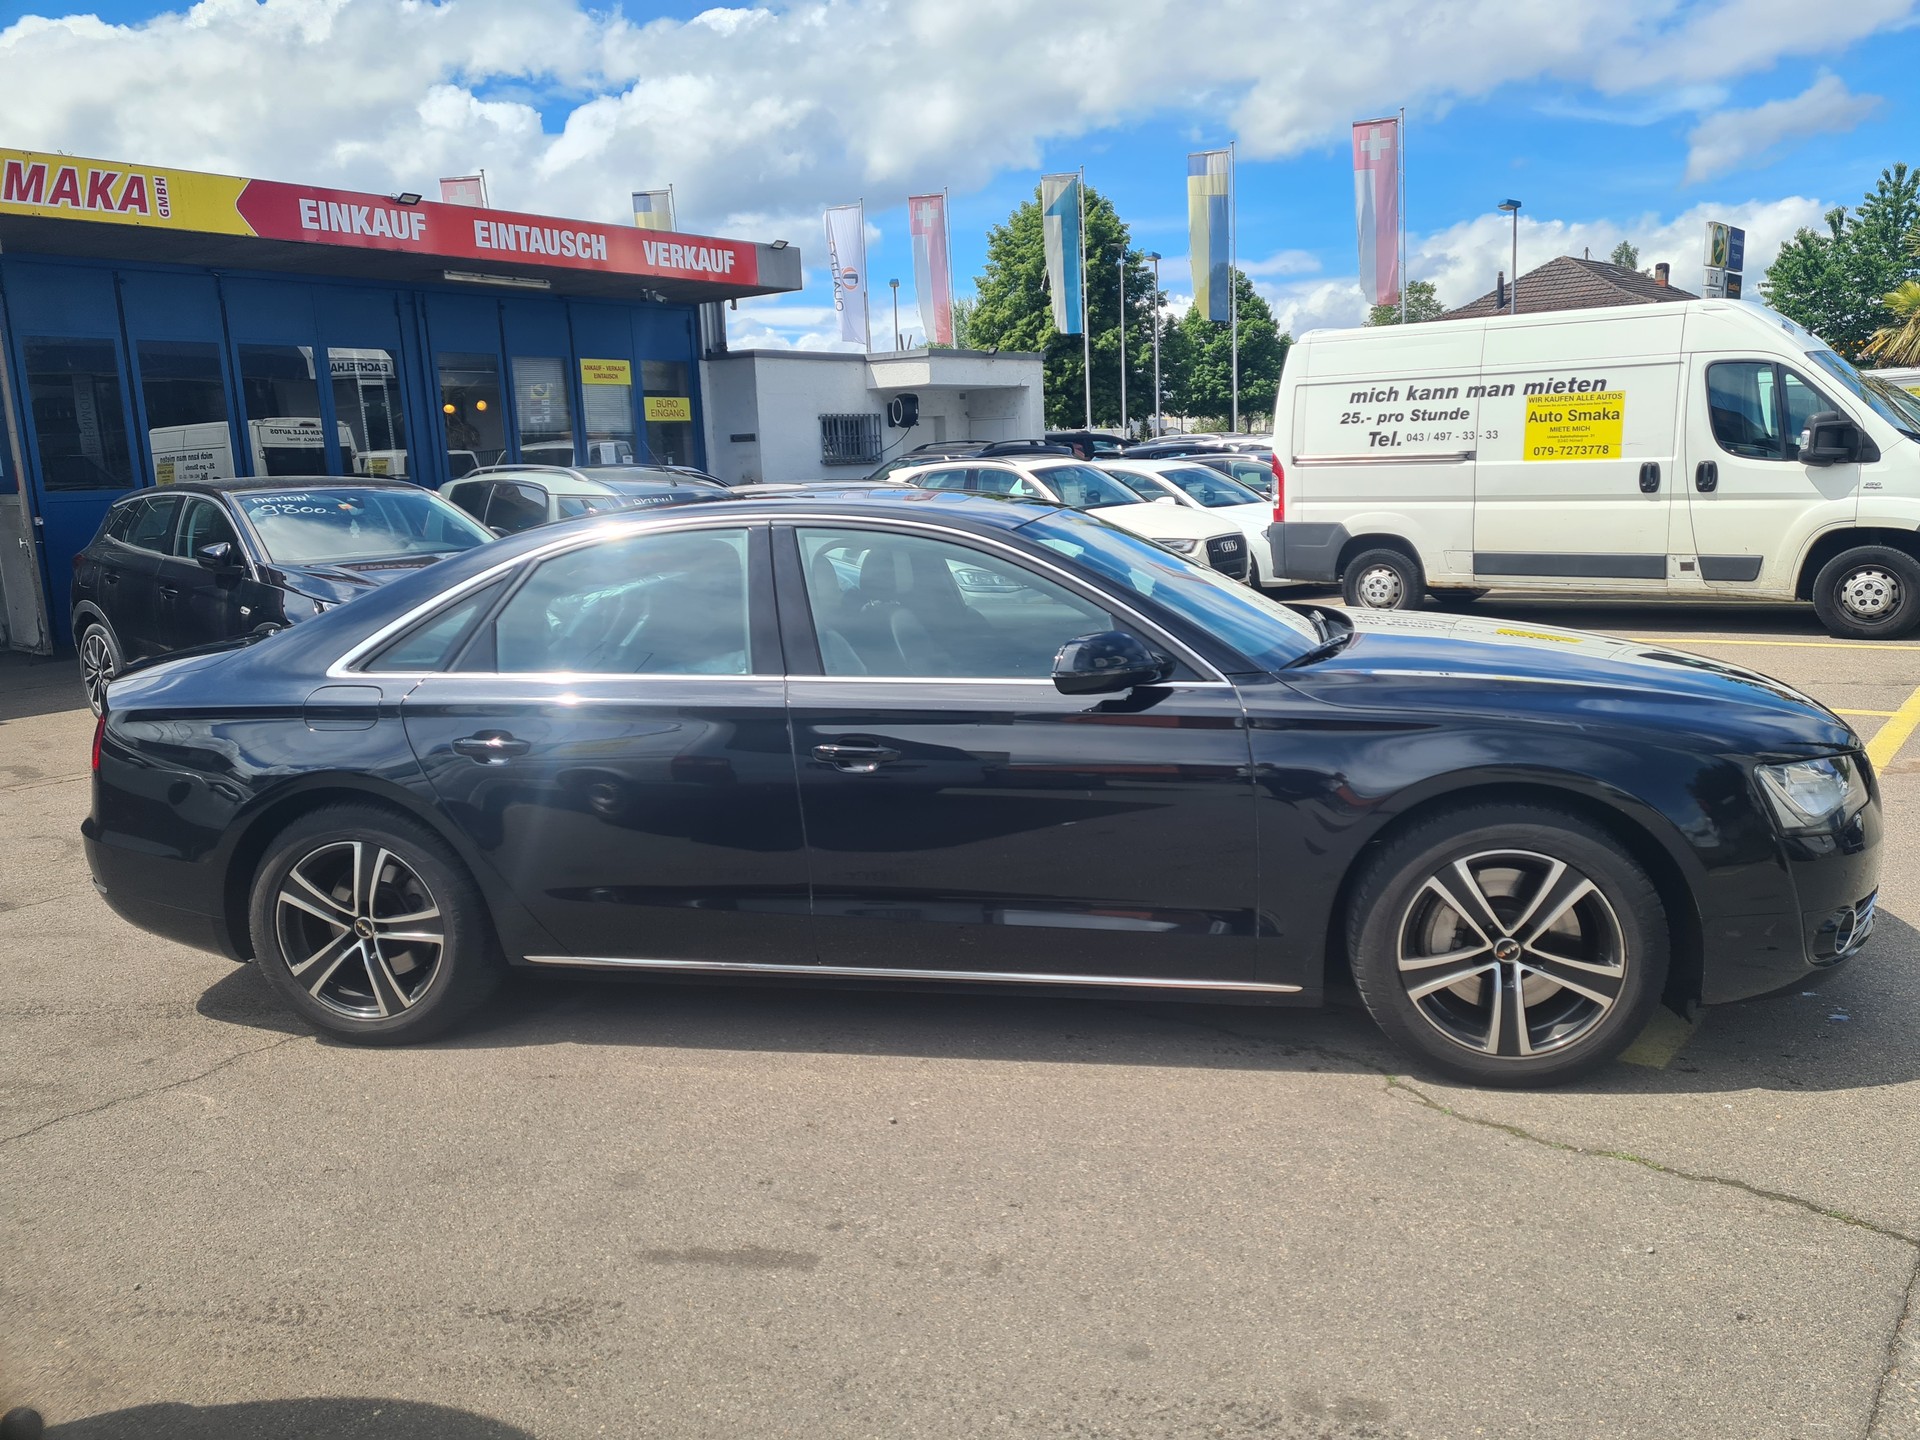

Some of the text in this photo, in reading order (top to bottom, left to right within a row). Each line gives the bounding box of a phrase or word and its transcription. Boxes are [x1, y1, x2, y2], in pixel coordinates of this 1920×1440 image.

[2, 160, 149, 215] MAKA
[154, 177, 170, 217] GMBH
[298, 198, 735, 274] EINKAUF EINTAUSCH VERKAUF
[583, 364, 602, 372] ANKAUF
[1349, 377, 1608, 404] mich kann man mieten
[656, 399, 678, 408] BÜRO
[1528, 396, 1543, 404] WIR
[1544, 395, 1575, 403] KAUFEN
[650, 409, 685, 418] EINGANG
[1340, 407, 1470, 426] 25.- pro Stunde
[1528, 407, 1620, 423] Auto Smaka
[1368, 431, 1402, 447] Tel.
[1406, 433, 1425, 442] 043
[1433, 432, 1453, 441] 497
[1462, 431, 1475, 440] 33
[1485, 430, 1499, 439] 33
[1533, 445, 1609, 456] 079-7273778
